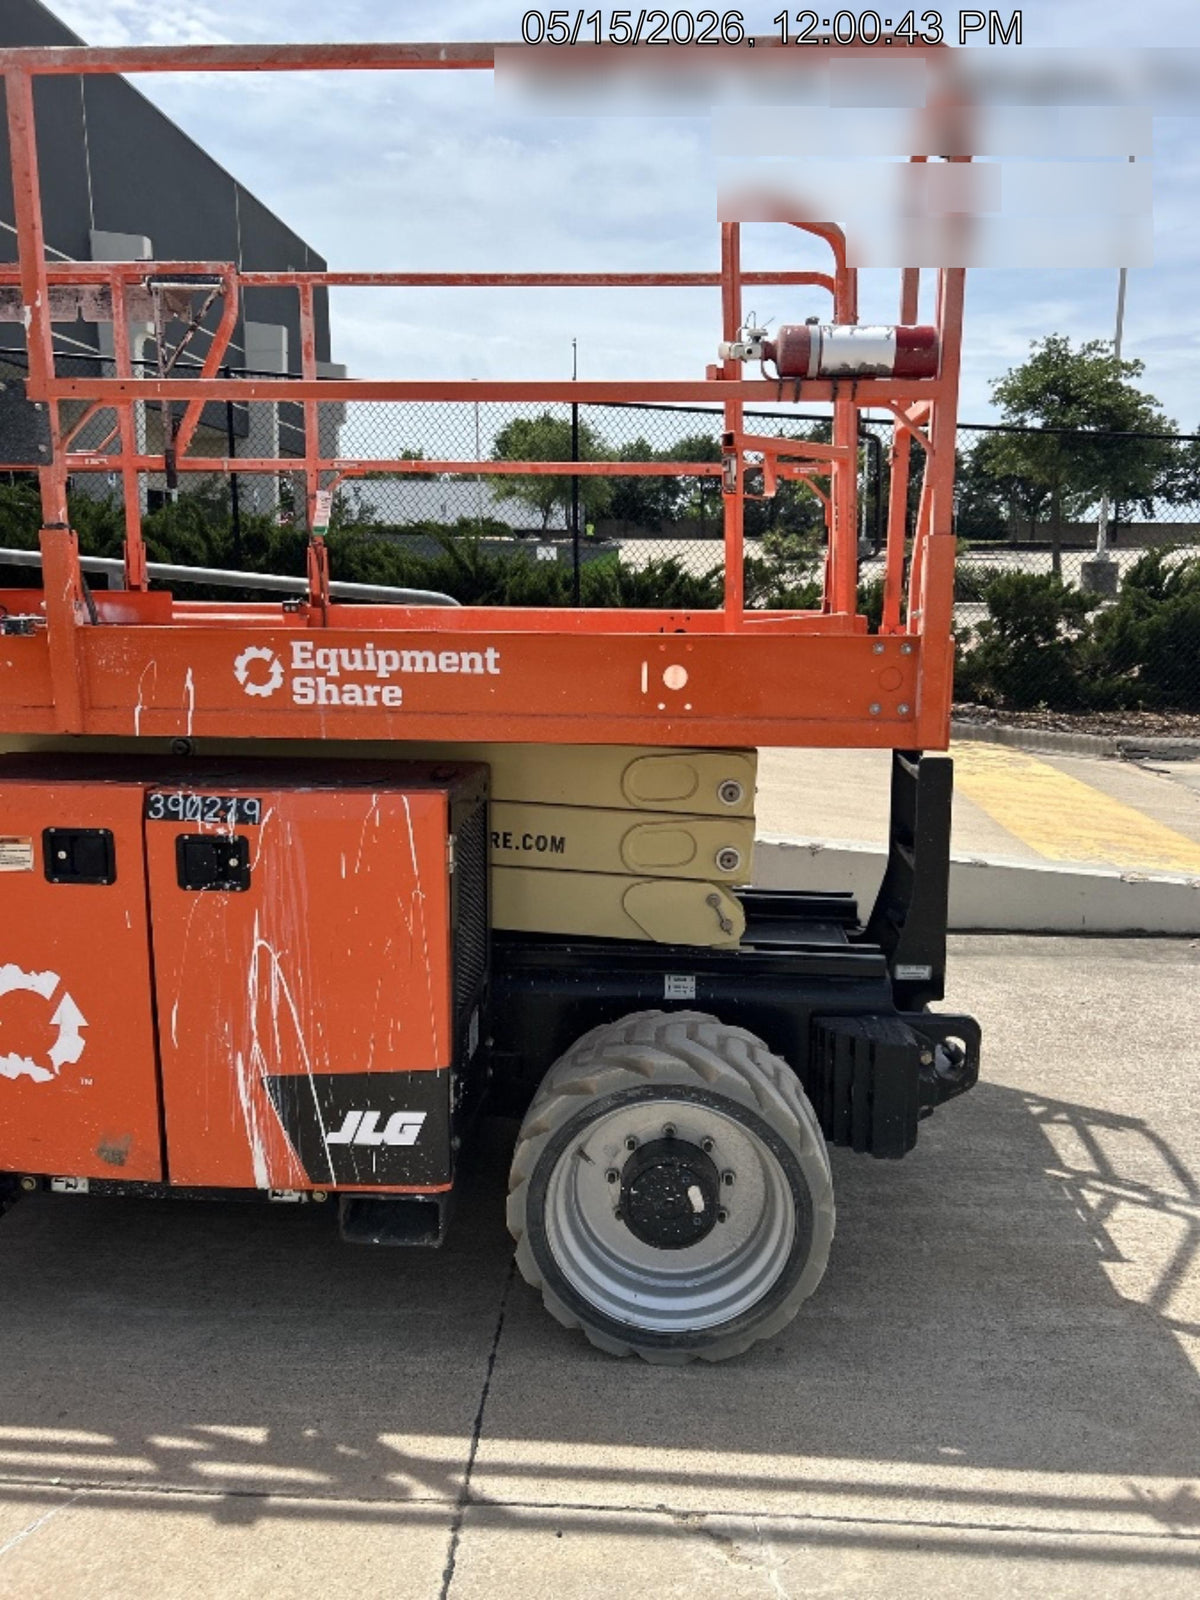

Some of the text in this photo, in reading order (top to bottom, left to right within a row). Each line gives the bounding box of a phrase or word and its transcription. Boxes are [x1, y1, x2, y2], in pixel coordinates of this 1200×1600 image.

[290, 641, 501, 678] Equipment
[292, 676, 403, 706] Share
[325, 1110, 428, 1146] JLG
